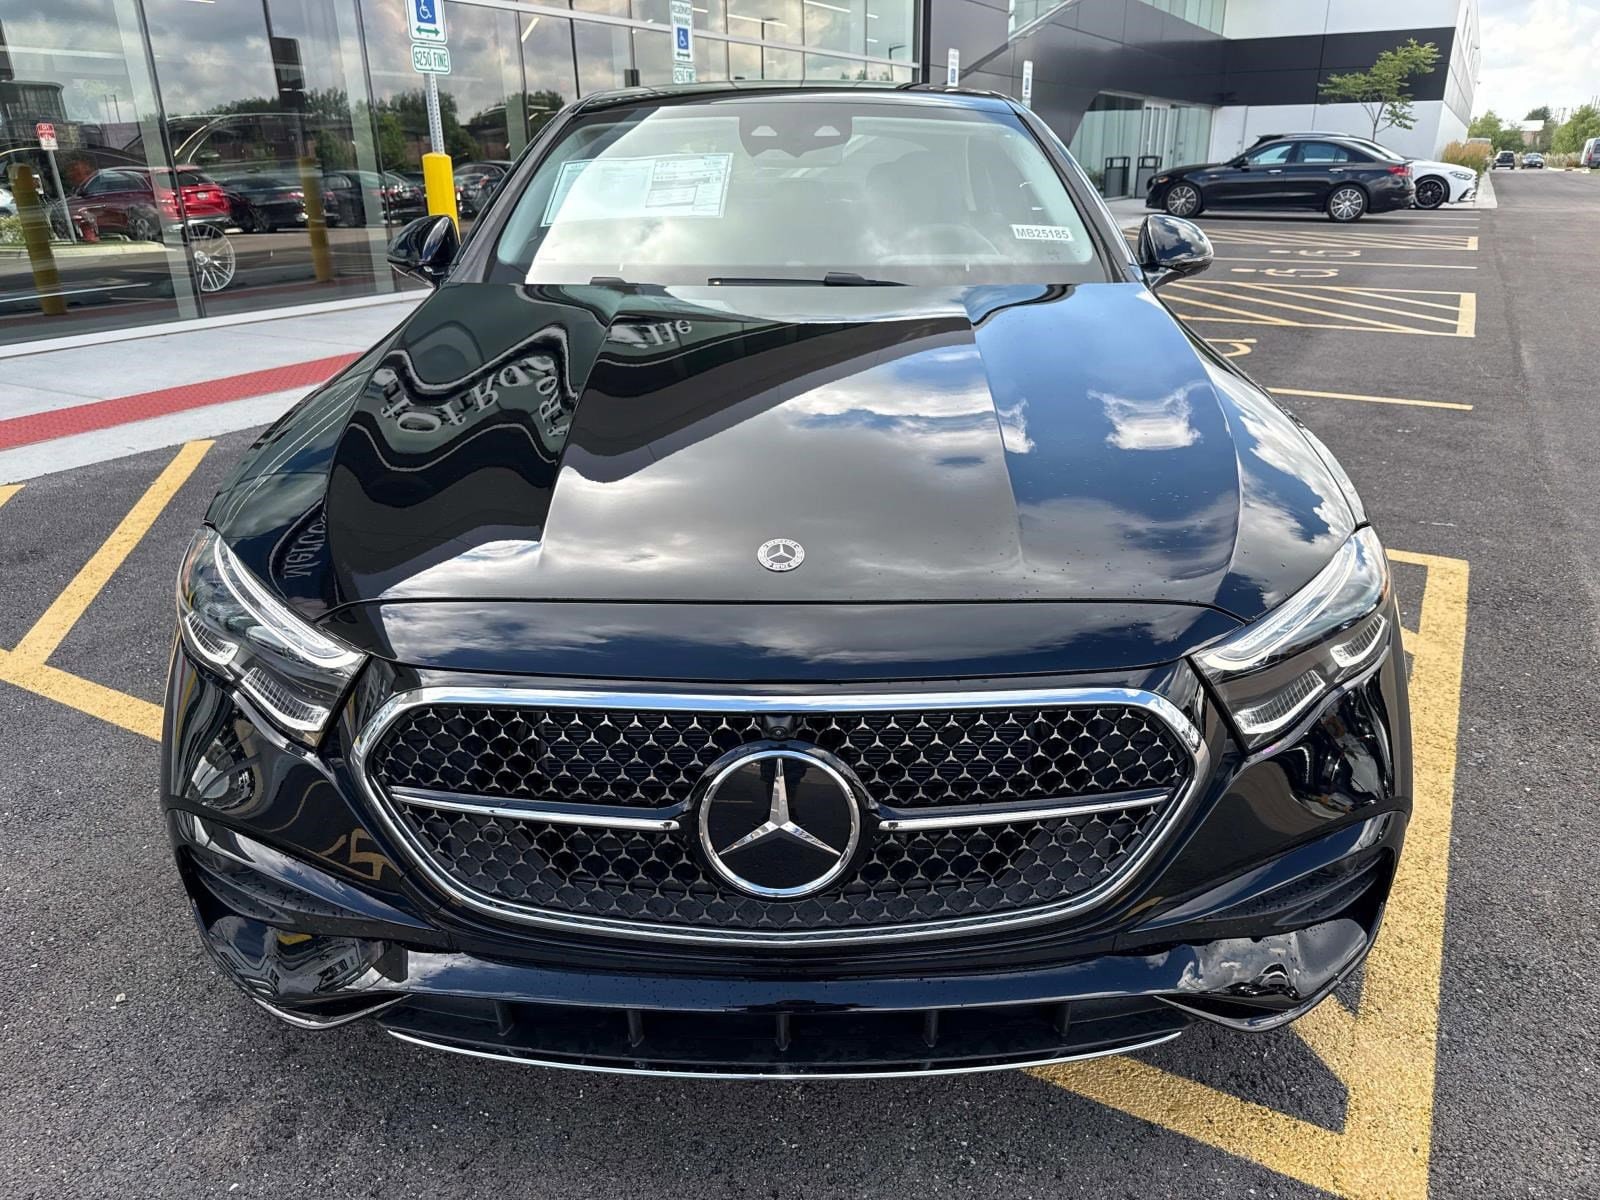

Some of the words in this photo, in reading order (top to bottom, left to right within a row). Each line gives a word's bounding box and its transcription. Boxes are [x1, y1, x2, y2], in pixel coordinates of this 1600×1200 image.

[415, 50, 432, 67] $250
[433, 52, 448, 68] FINE
[1015, 227, 1070, 240] MB25185
